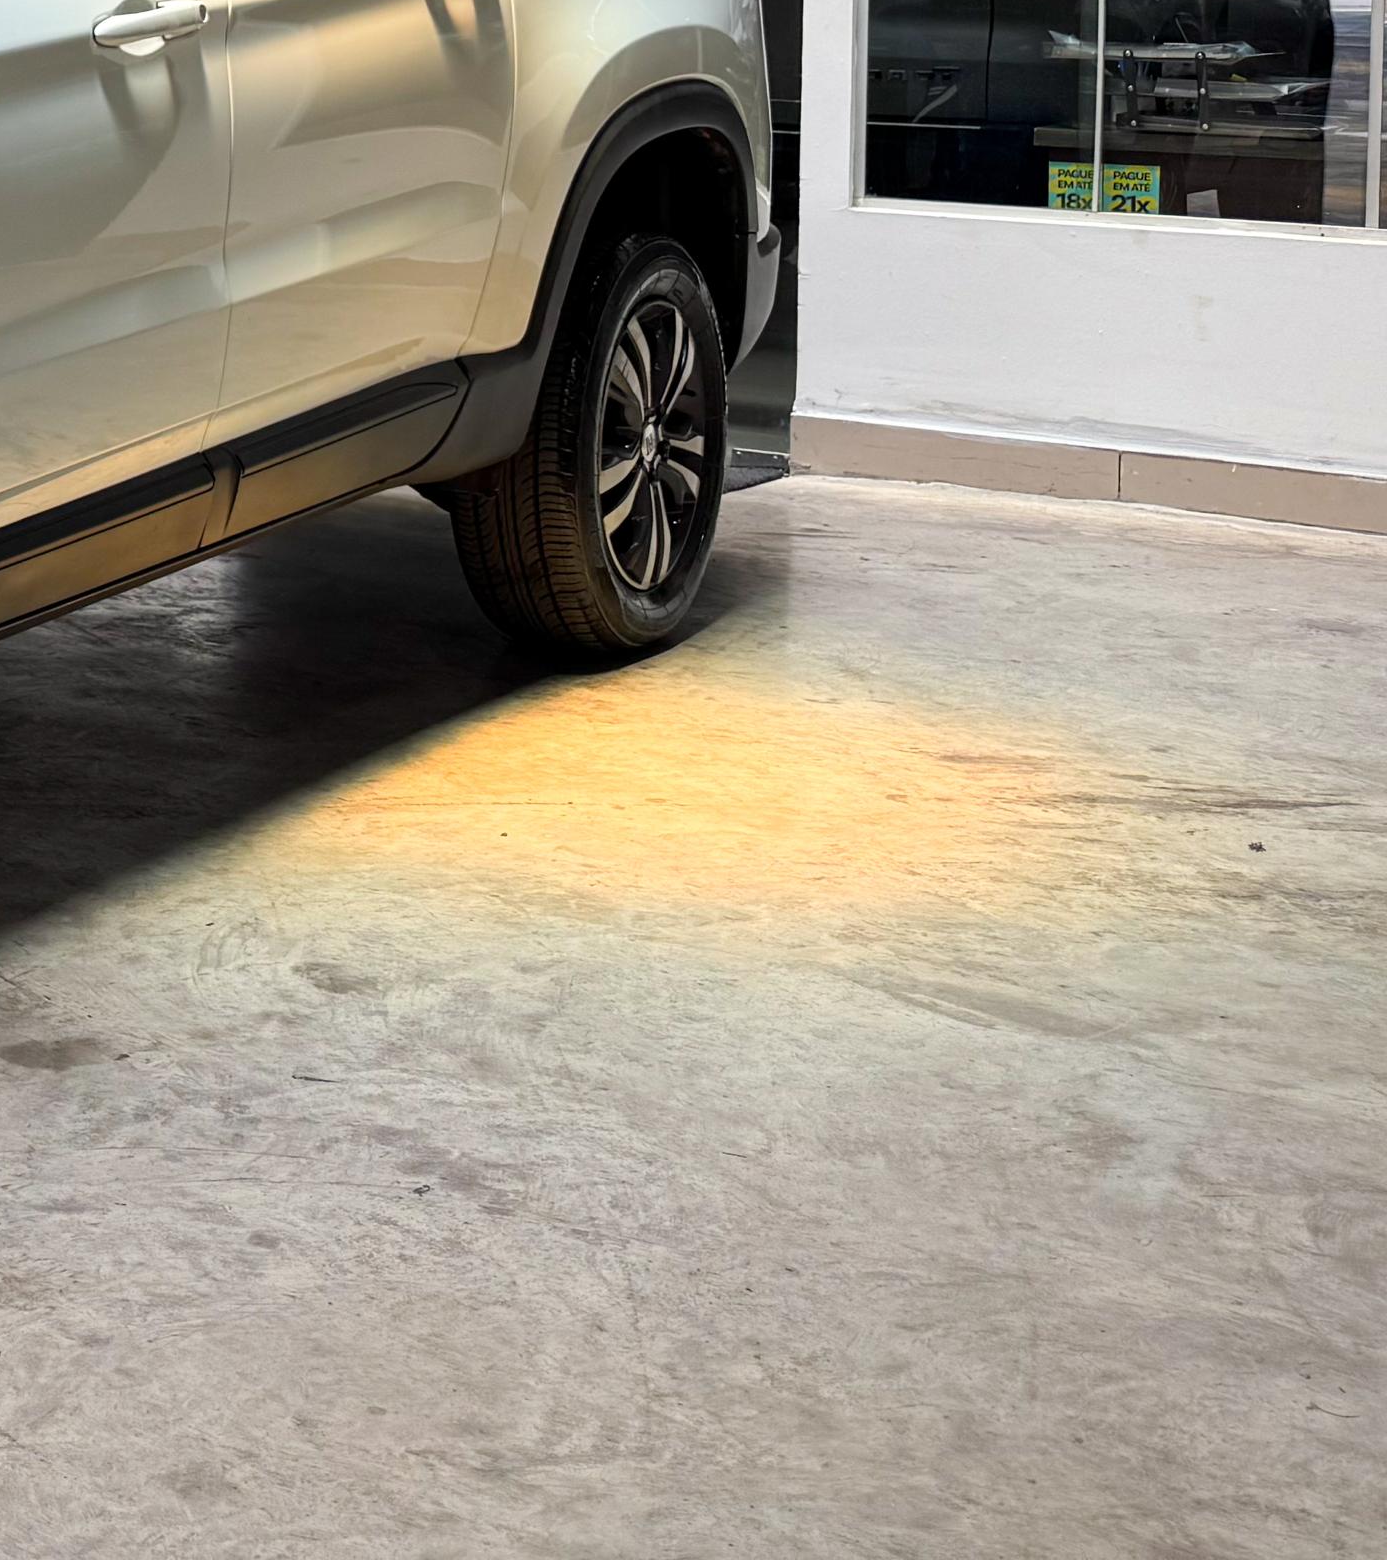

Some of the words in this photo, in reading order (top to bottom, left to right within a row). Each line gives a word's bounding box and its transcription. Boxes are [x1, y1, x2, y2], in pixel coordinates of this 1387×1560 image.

[1113, 171, 1151, 181] PAGUE
[1057, 180, 1074, 190] EM
[1113, 182, 1129, 192] EM
